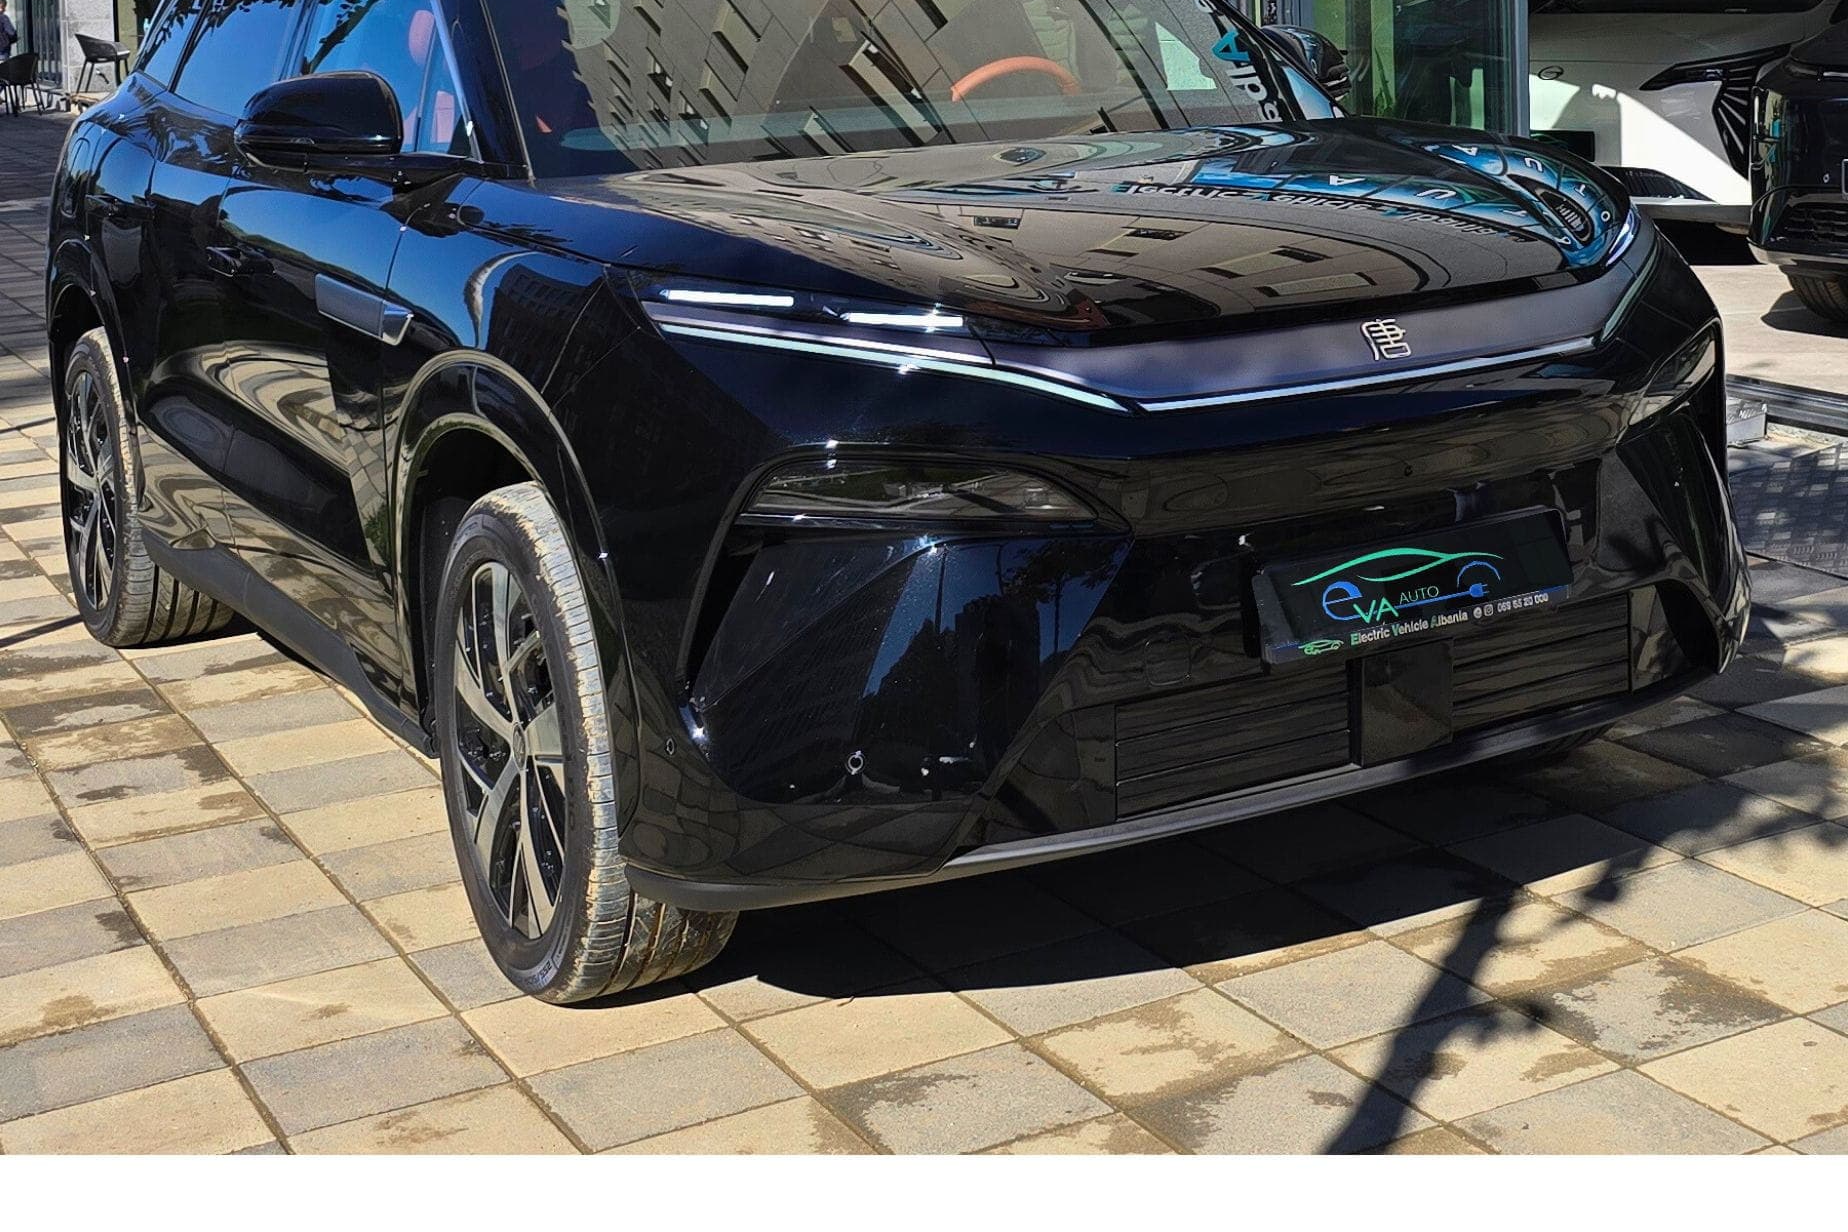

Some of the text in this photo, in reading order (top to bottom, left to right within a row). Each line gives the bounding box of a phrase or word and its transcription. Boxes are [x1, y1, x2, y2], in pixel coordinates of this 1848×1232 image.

[1361, 318, 1412, 361] 唐
[1400, 585, 1440, 604] AUTO
[1350, 627, 1390, 646] Electric
[1391, 617, 1429, 637] Vehicle
[1430, 609, 1469, 628] Albania
